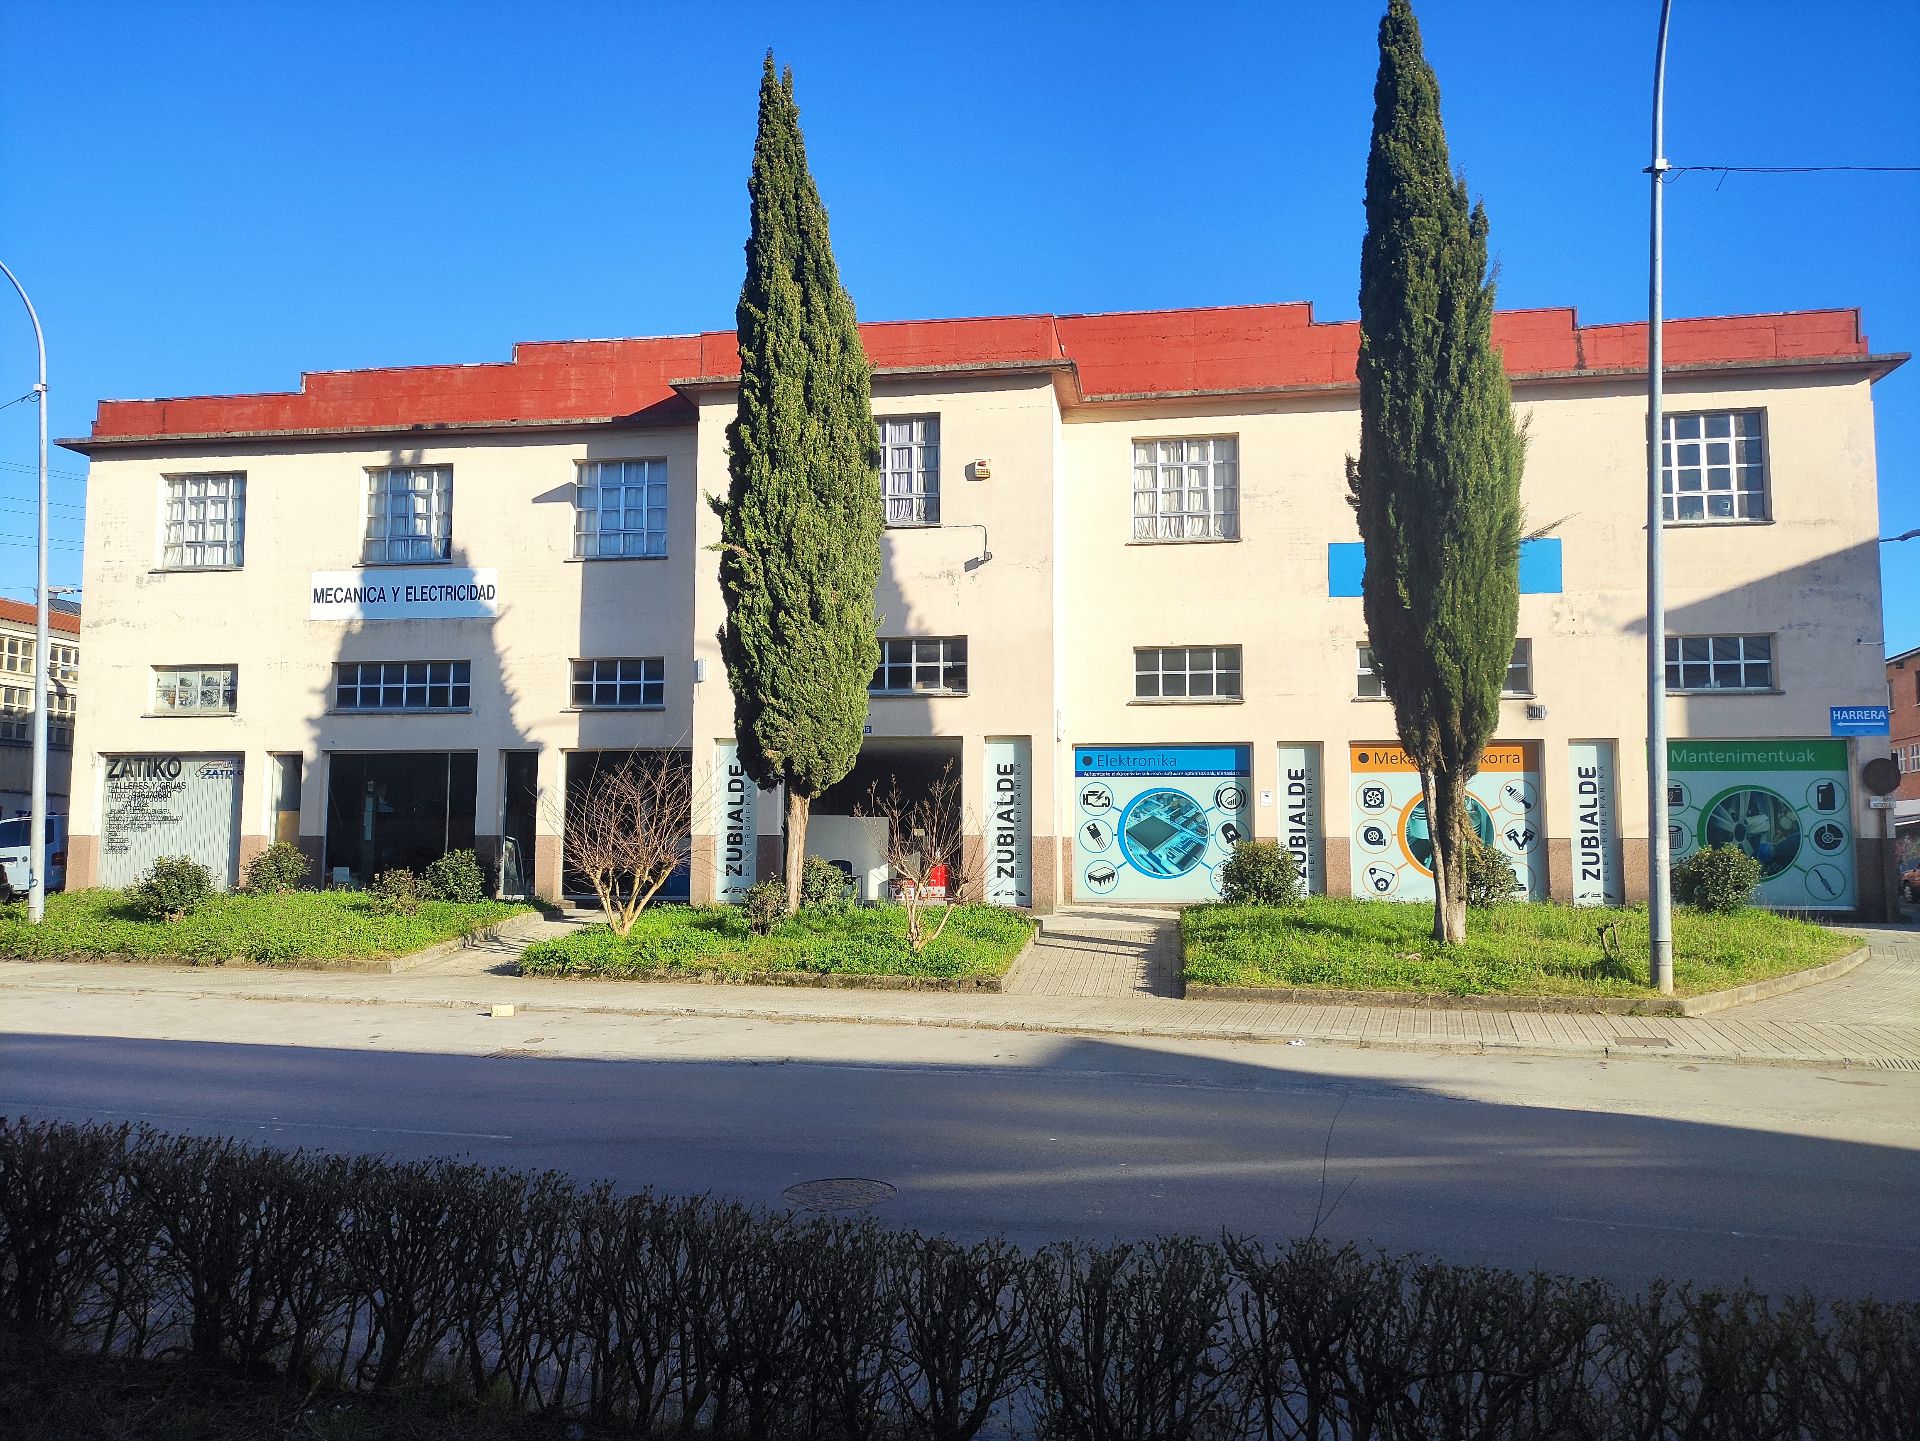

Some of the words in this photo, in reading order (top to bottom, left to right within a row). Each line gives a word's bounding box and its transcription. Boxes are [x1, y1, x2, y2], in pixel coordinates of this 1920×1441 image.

[313, 586, 387, 604] MECANICA
[391, 586, 401, 603] Y
[405, 584, 496, 602] ELECTRICIDAD
[1832, 710, 1887, 720] HARRERA
[107, 756, 182, 779] ZATIKO
[1097, 754, 1177, 767] Elektronika
[1671, 749, 1816, 763] Mantenimentuak
[725, 764, 745, 877] ZUBIALDE
[996, 763, 1015, 879] ZUBIALDE
[1306, 768, 1315, 879] ELEKTROMEKANIKA
[1577, 766, 1601, 881] ZUBIALDE
